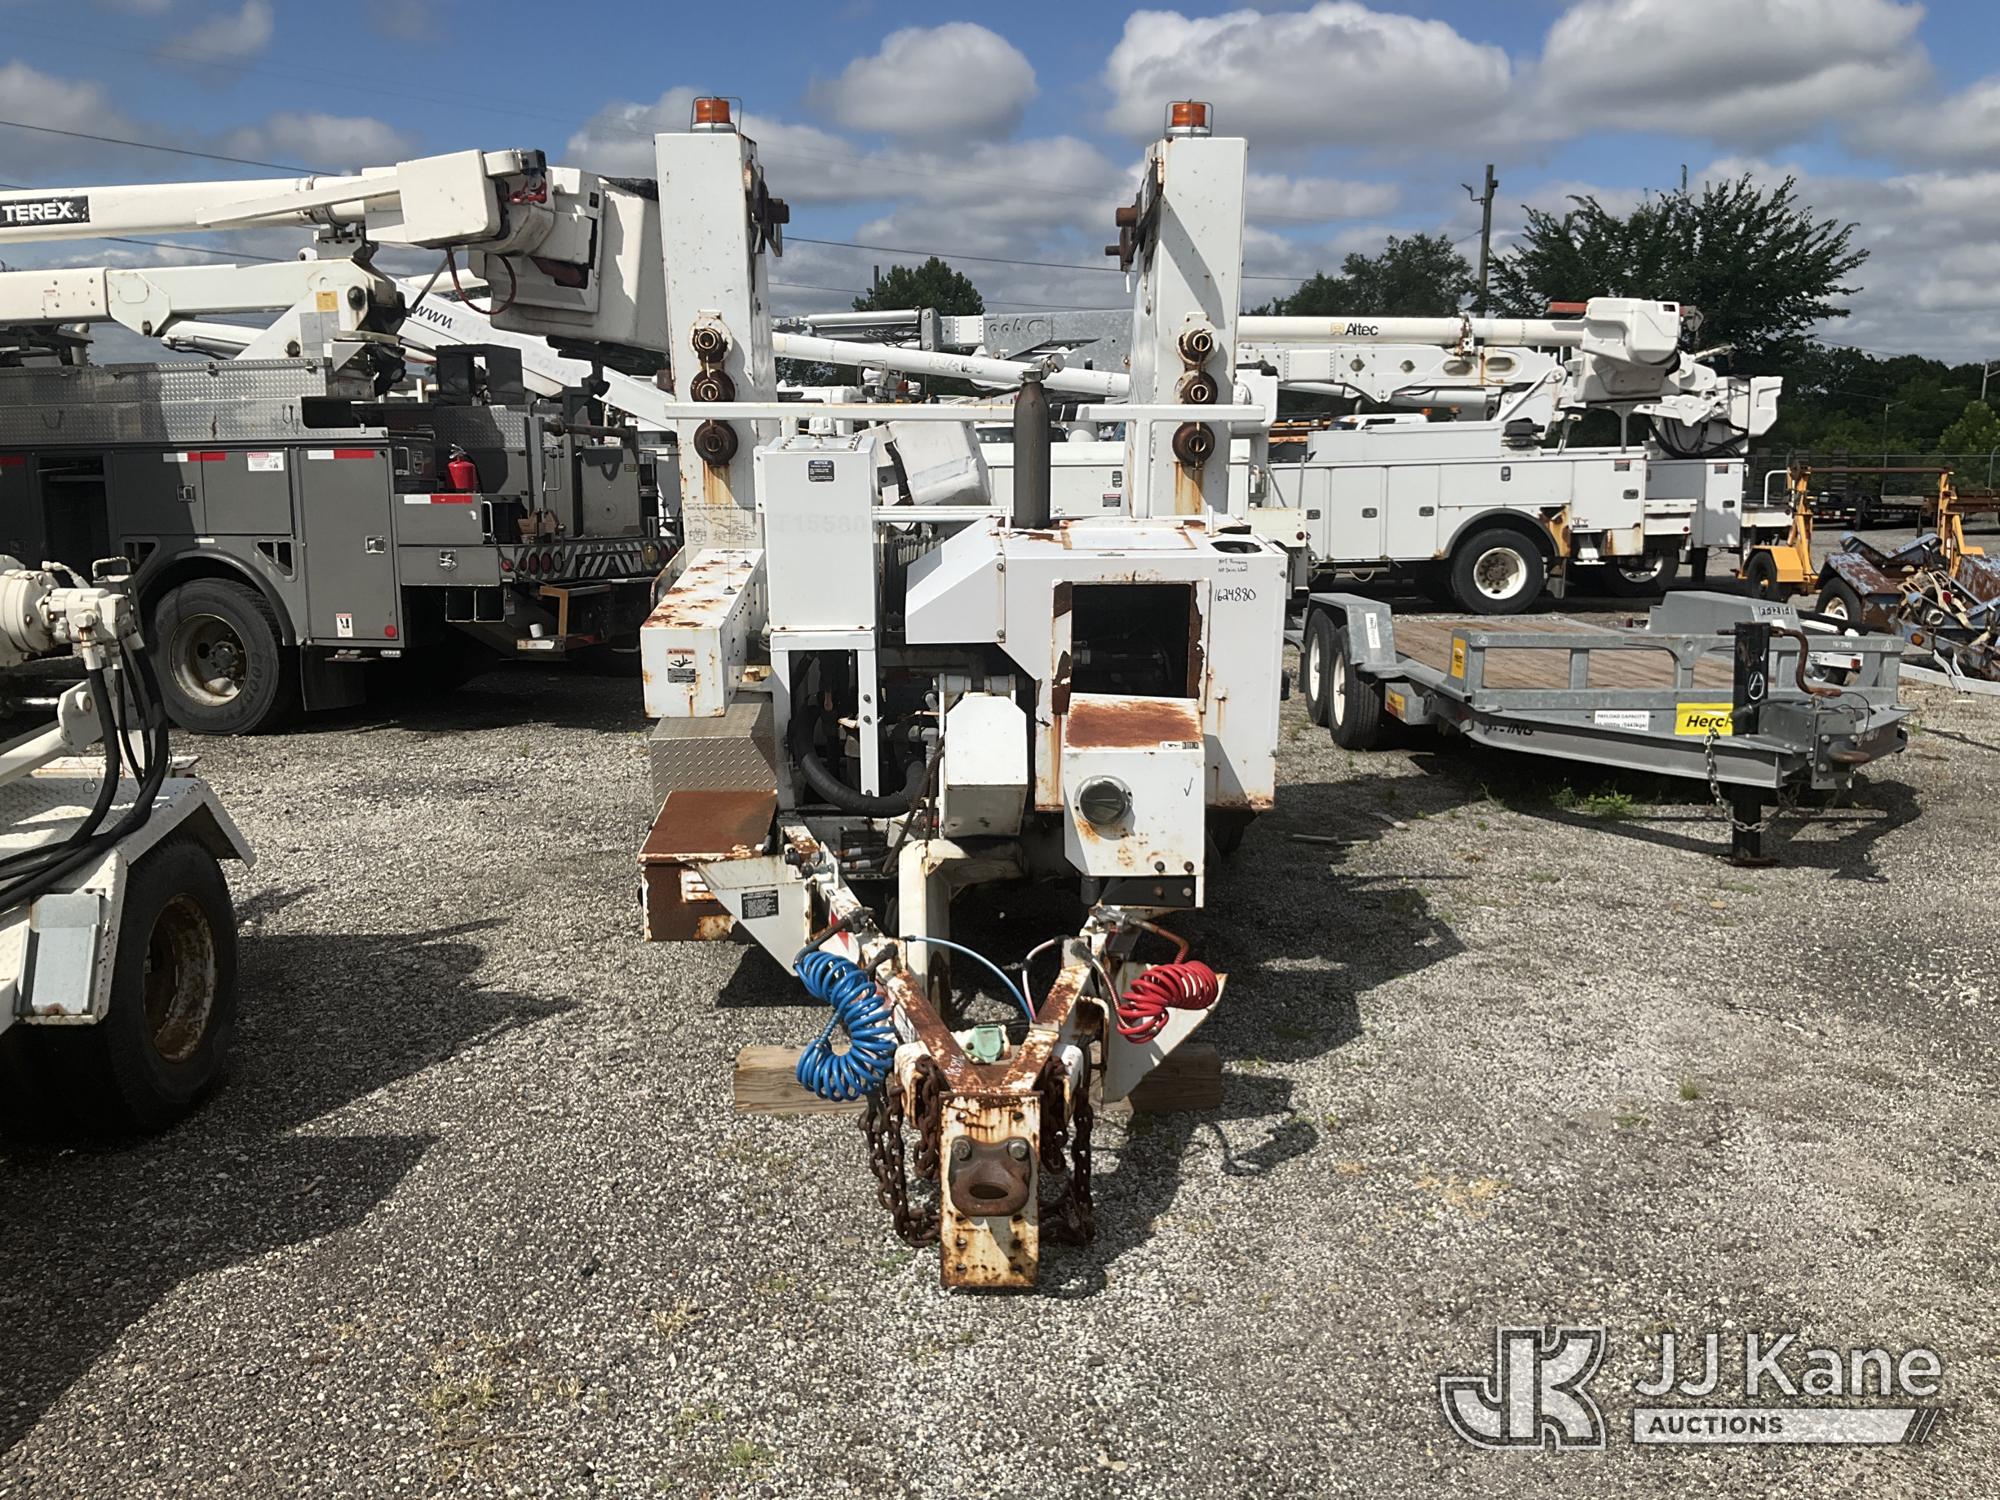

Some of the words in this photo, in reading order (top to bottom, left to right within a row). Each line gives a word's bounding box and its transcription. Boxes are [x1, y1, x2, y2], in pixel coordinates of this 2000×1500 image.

[2, 201, 73, 222] TEREX
[1345, 322, 1379, 336] Altec
[1214, 587, 1257, 602] 1624880
